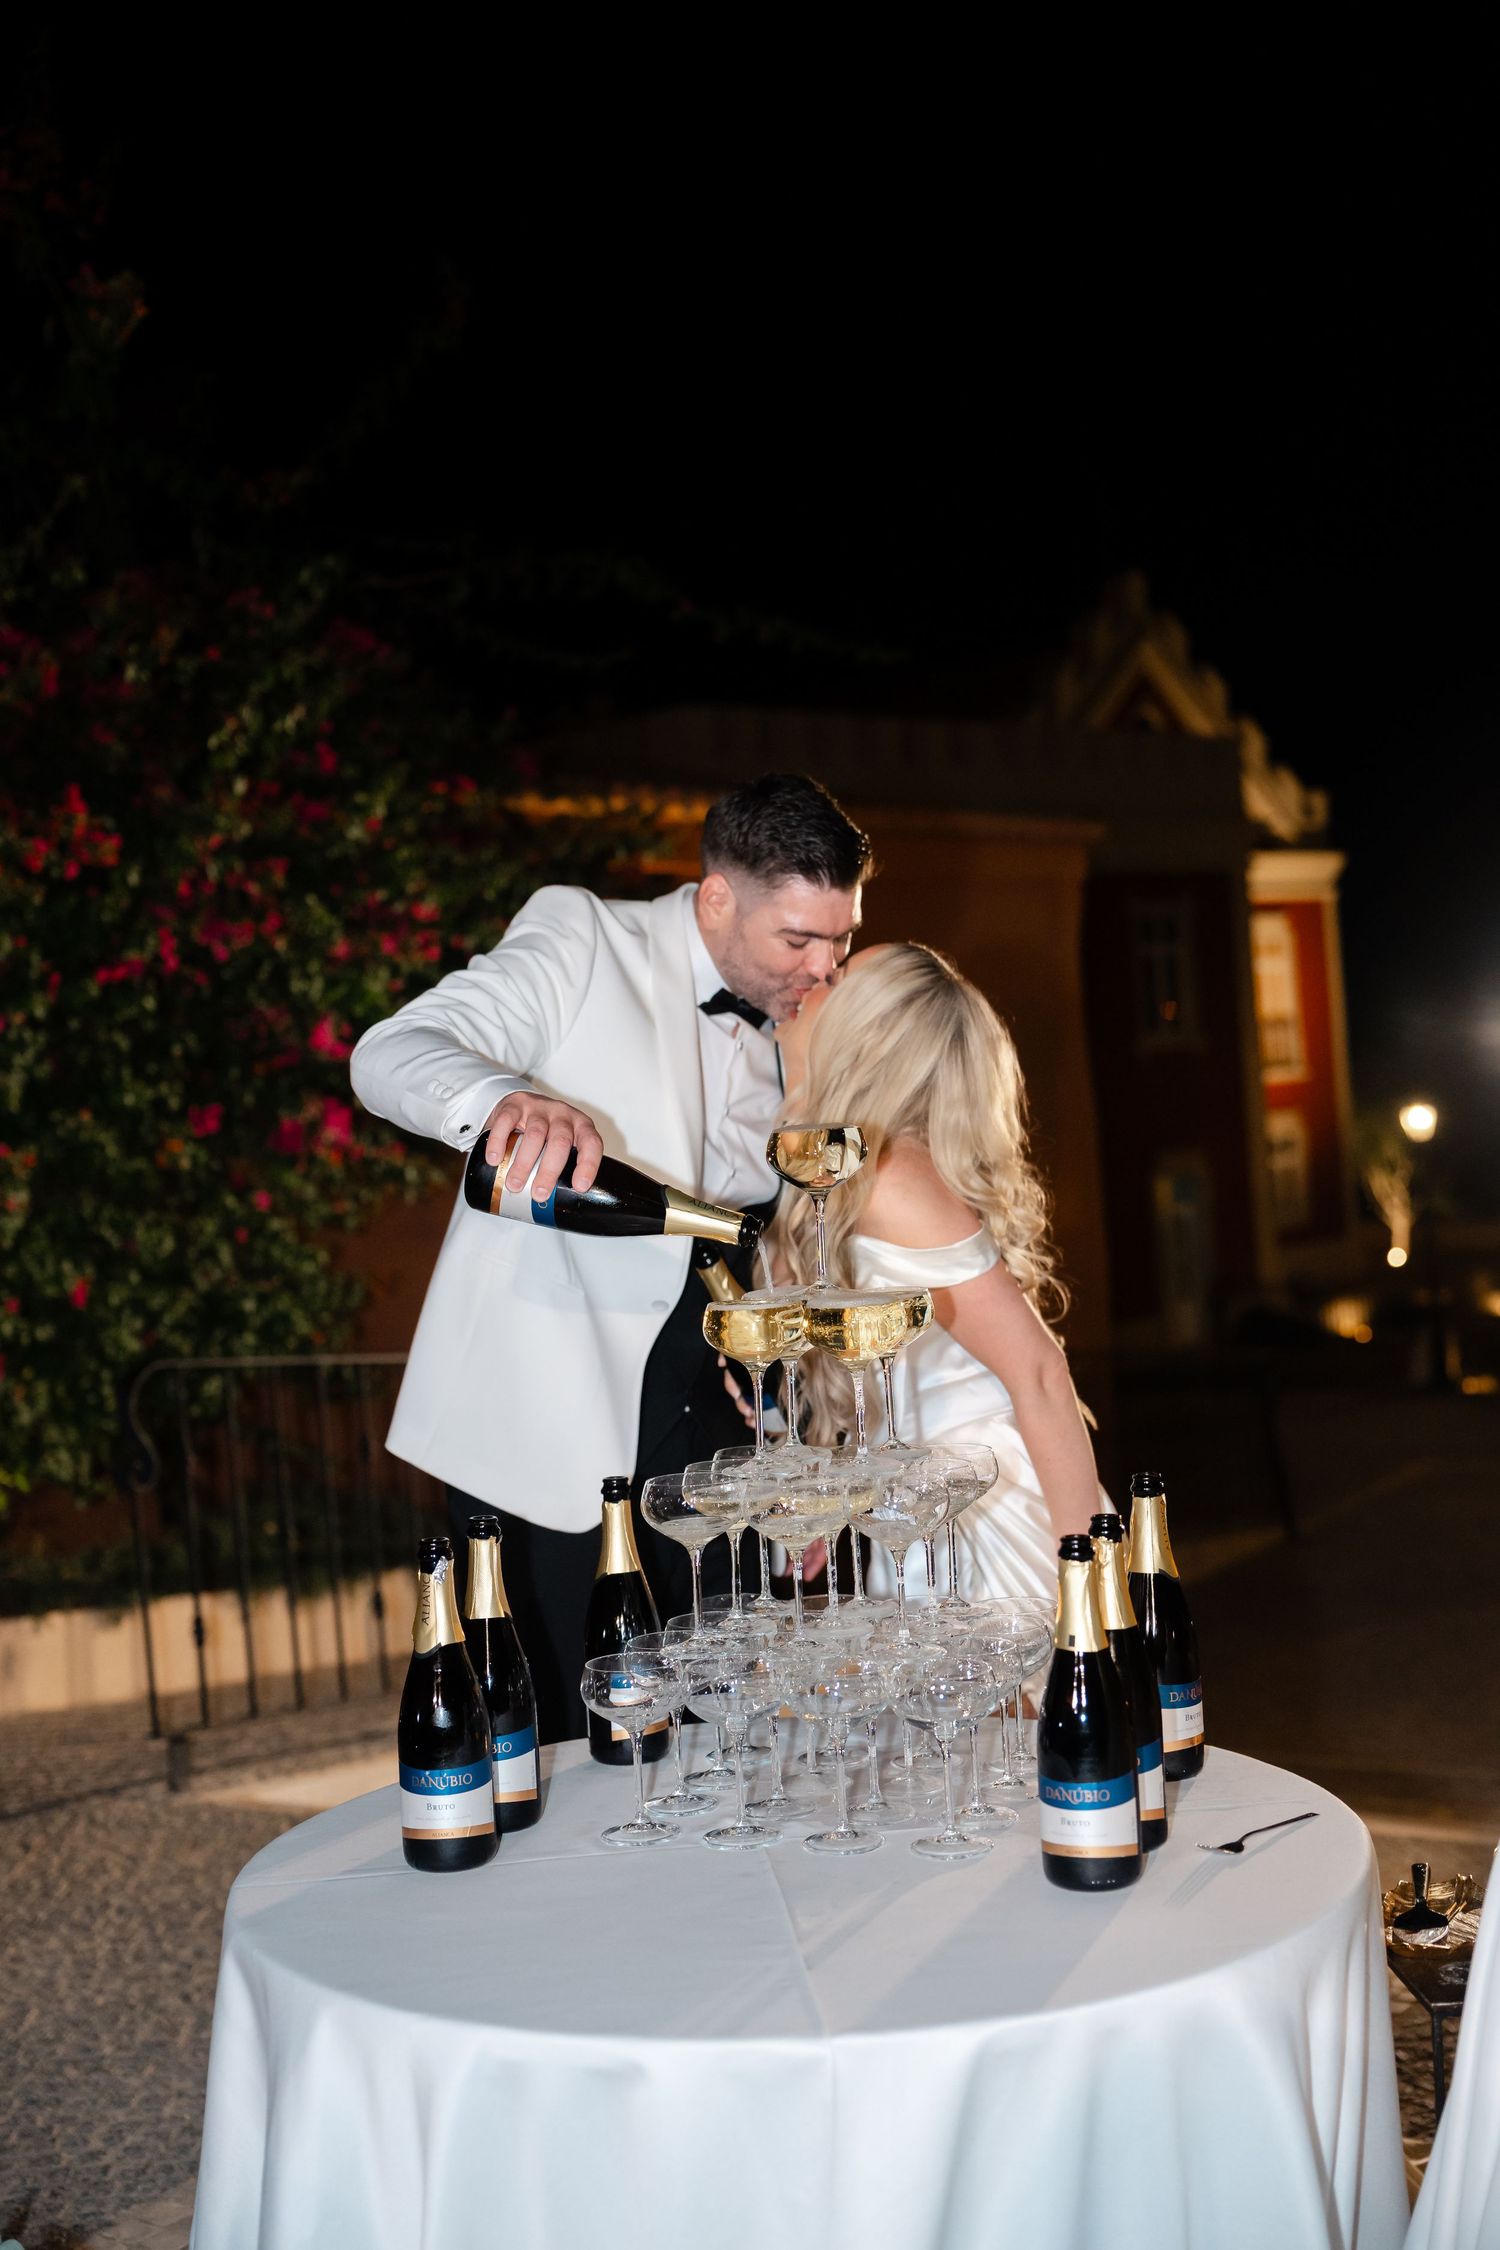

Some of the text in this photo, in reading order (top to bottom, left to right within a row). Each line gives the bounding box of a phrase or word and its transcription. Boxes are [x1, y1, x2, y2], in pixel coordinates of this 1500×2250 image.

[421, 1573, 431, 1626] ALIANC
[411, 1772, 473, 1790] DANÚBIO
[1045, 1786, 1111, 1805] DANÚBIO
